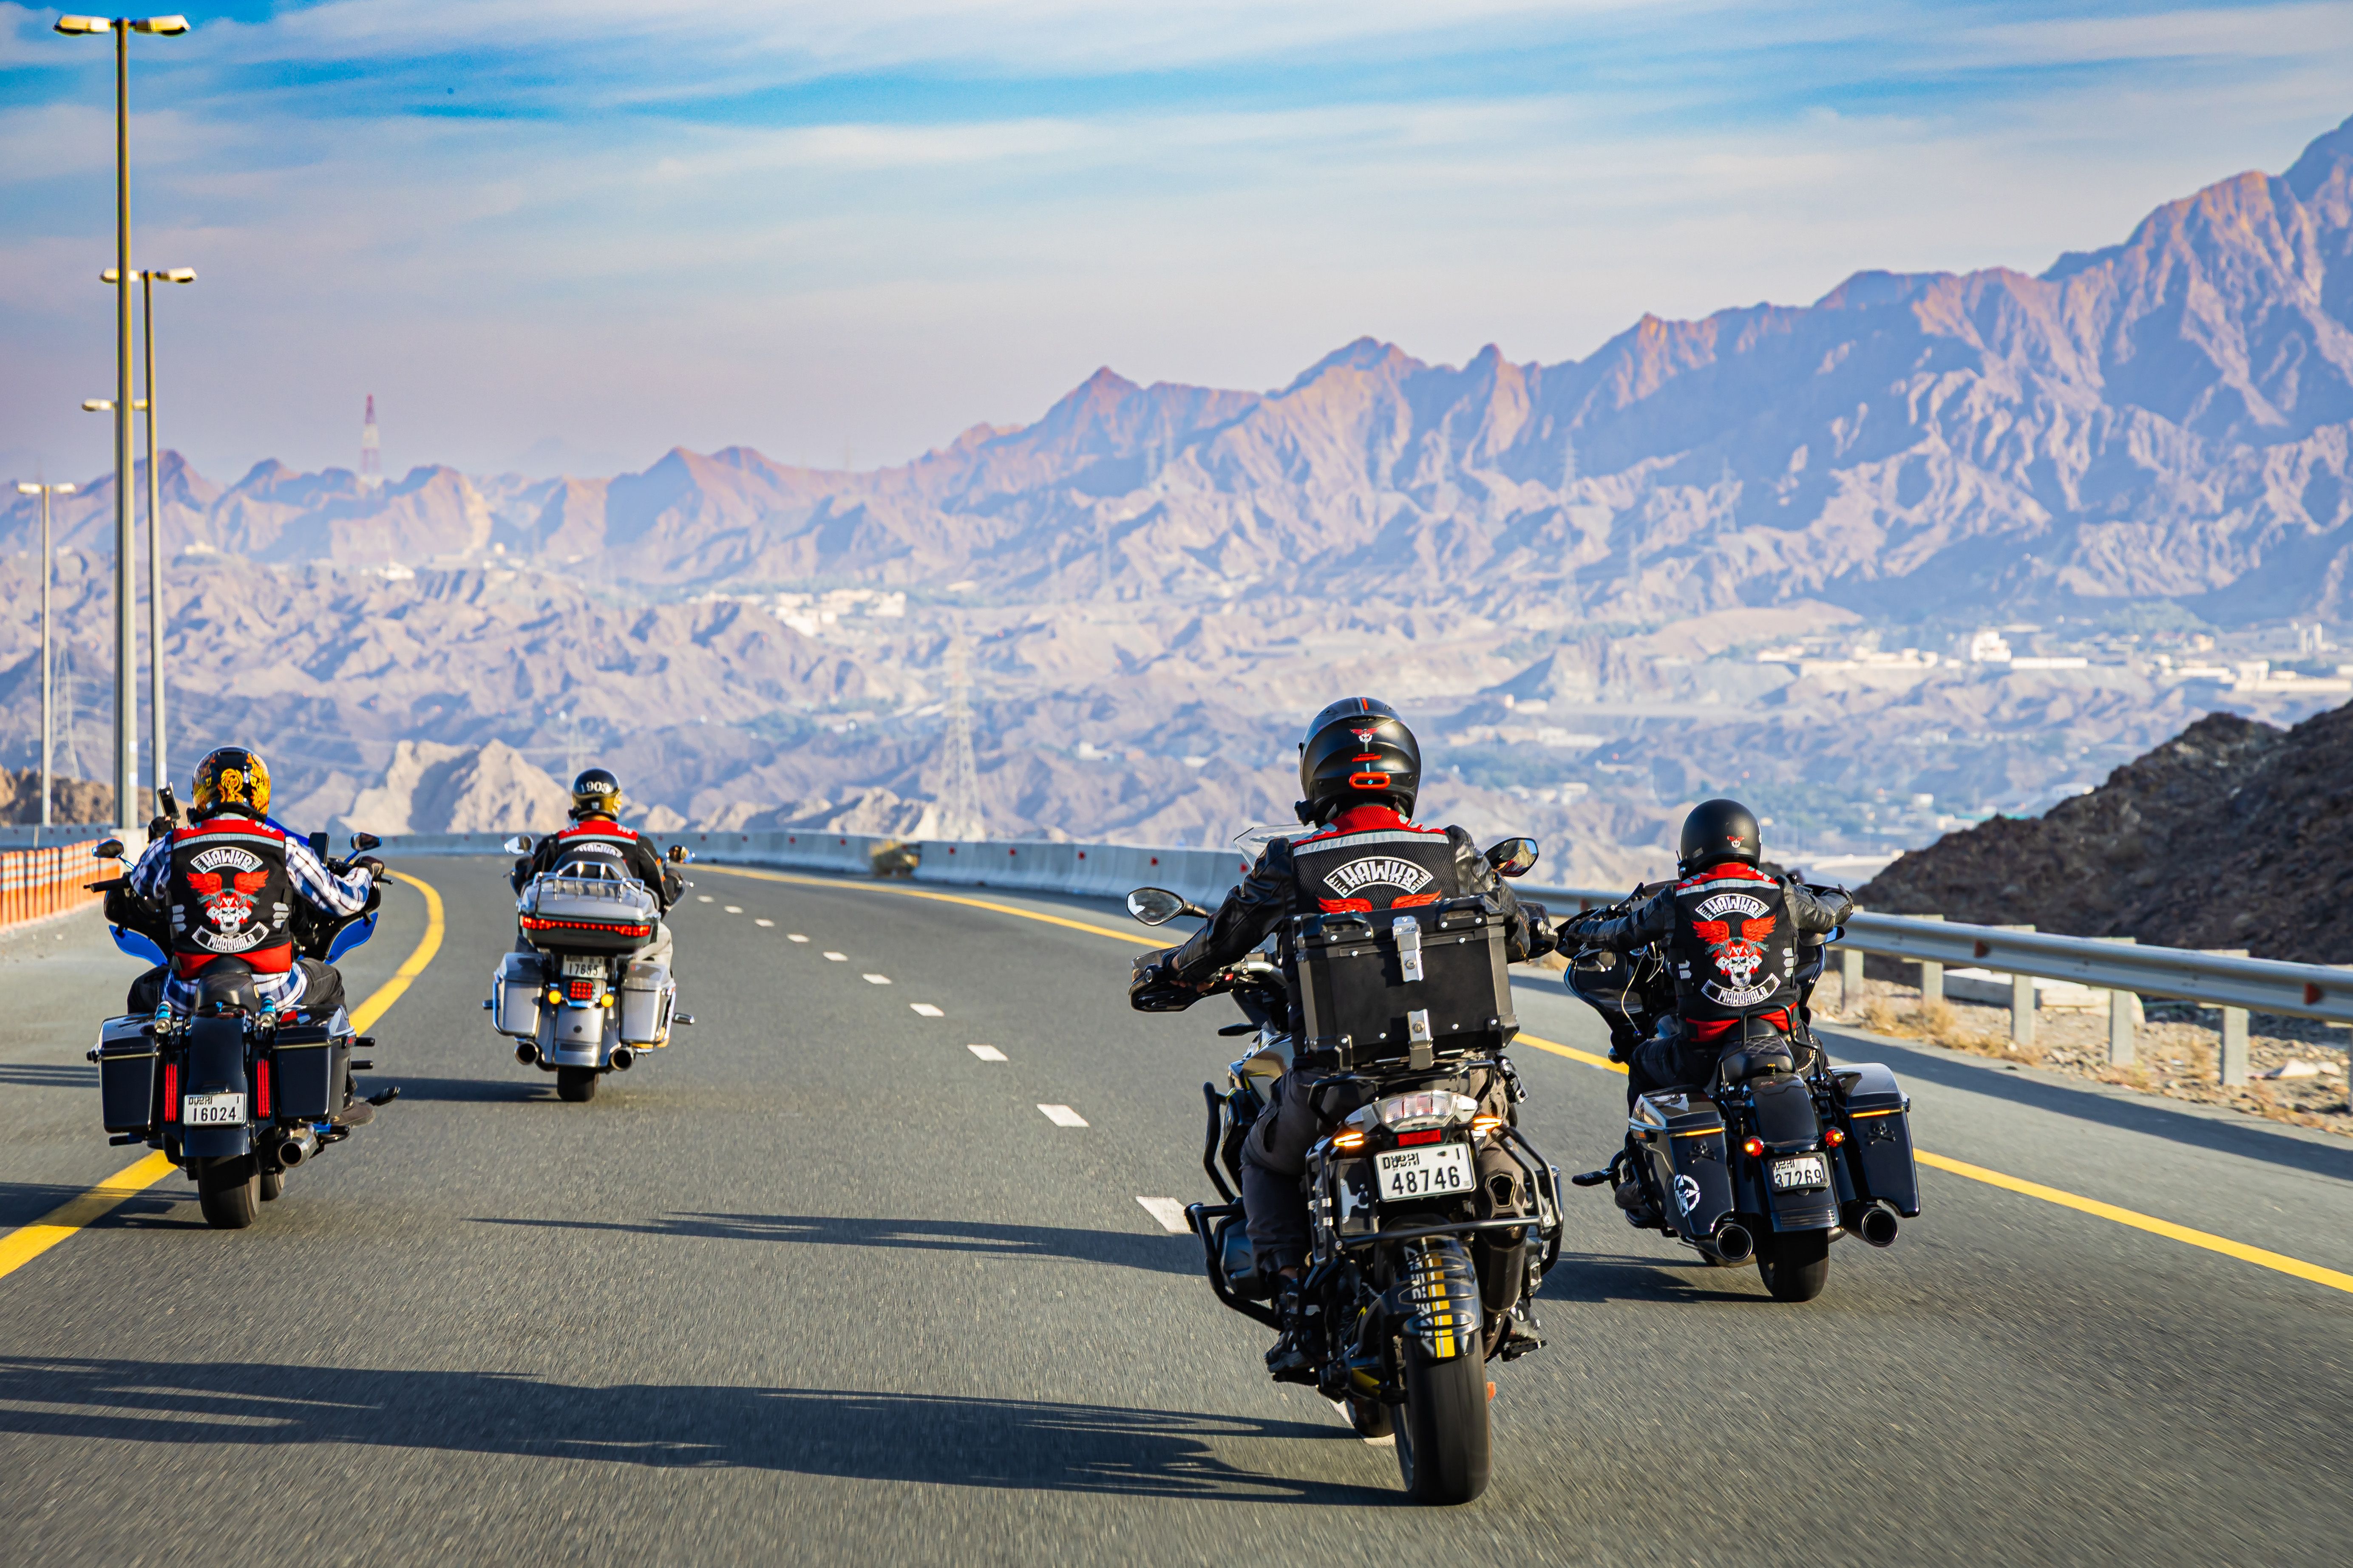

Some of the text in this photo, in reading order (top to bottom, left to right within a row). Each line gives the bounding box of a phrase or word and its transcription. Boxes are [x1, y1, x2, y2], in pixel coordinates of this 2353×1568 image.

[199, 849, 253, 869] HAWKS
[1337, 860, 1419, 889] HAWKS
[1704, 896, 1759, 915] HAWKS
[193, 1106, 237, 1122] 16024
[1392, 1166, 1460, 1195] 48746
[1775, 1169, 1823, 1188] 37269
